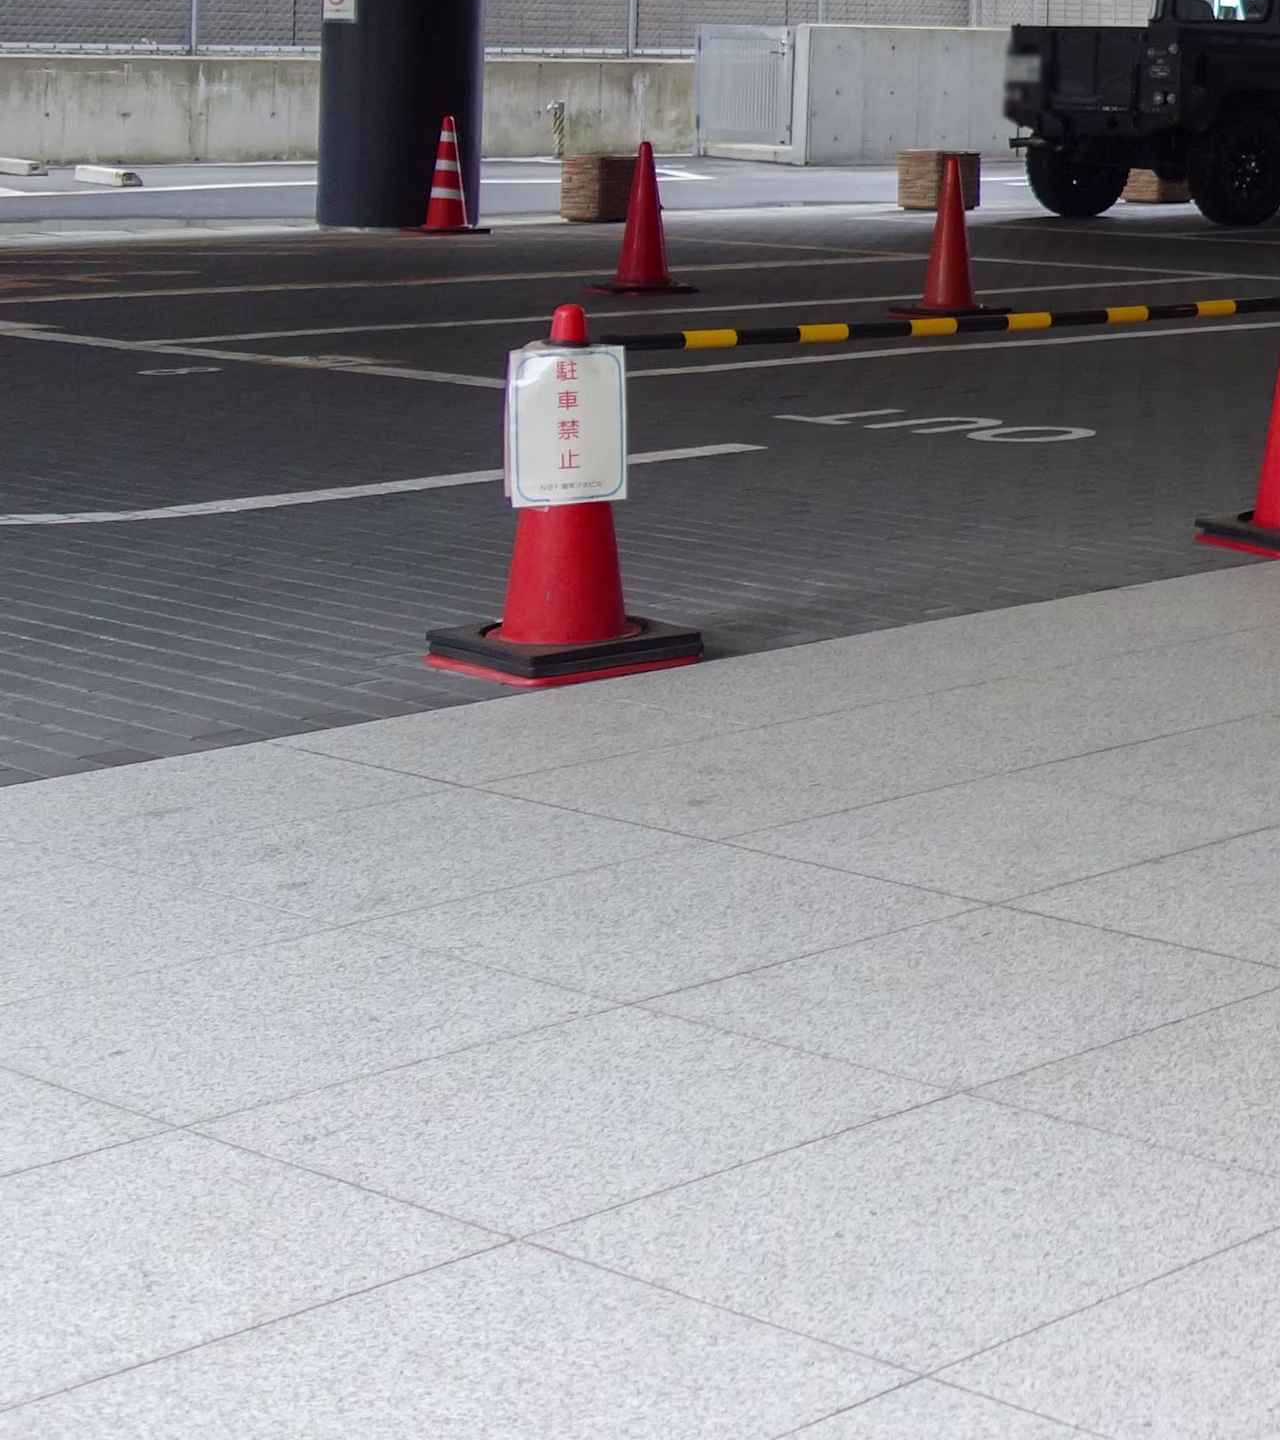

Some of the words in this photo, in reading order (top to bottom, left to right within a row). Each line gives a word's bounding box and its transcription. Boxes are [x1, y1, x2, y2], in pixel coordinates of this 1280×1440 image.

[555, 360, 580, 470] 駐車禁止
[773, 408, 1097, 443] OUT
